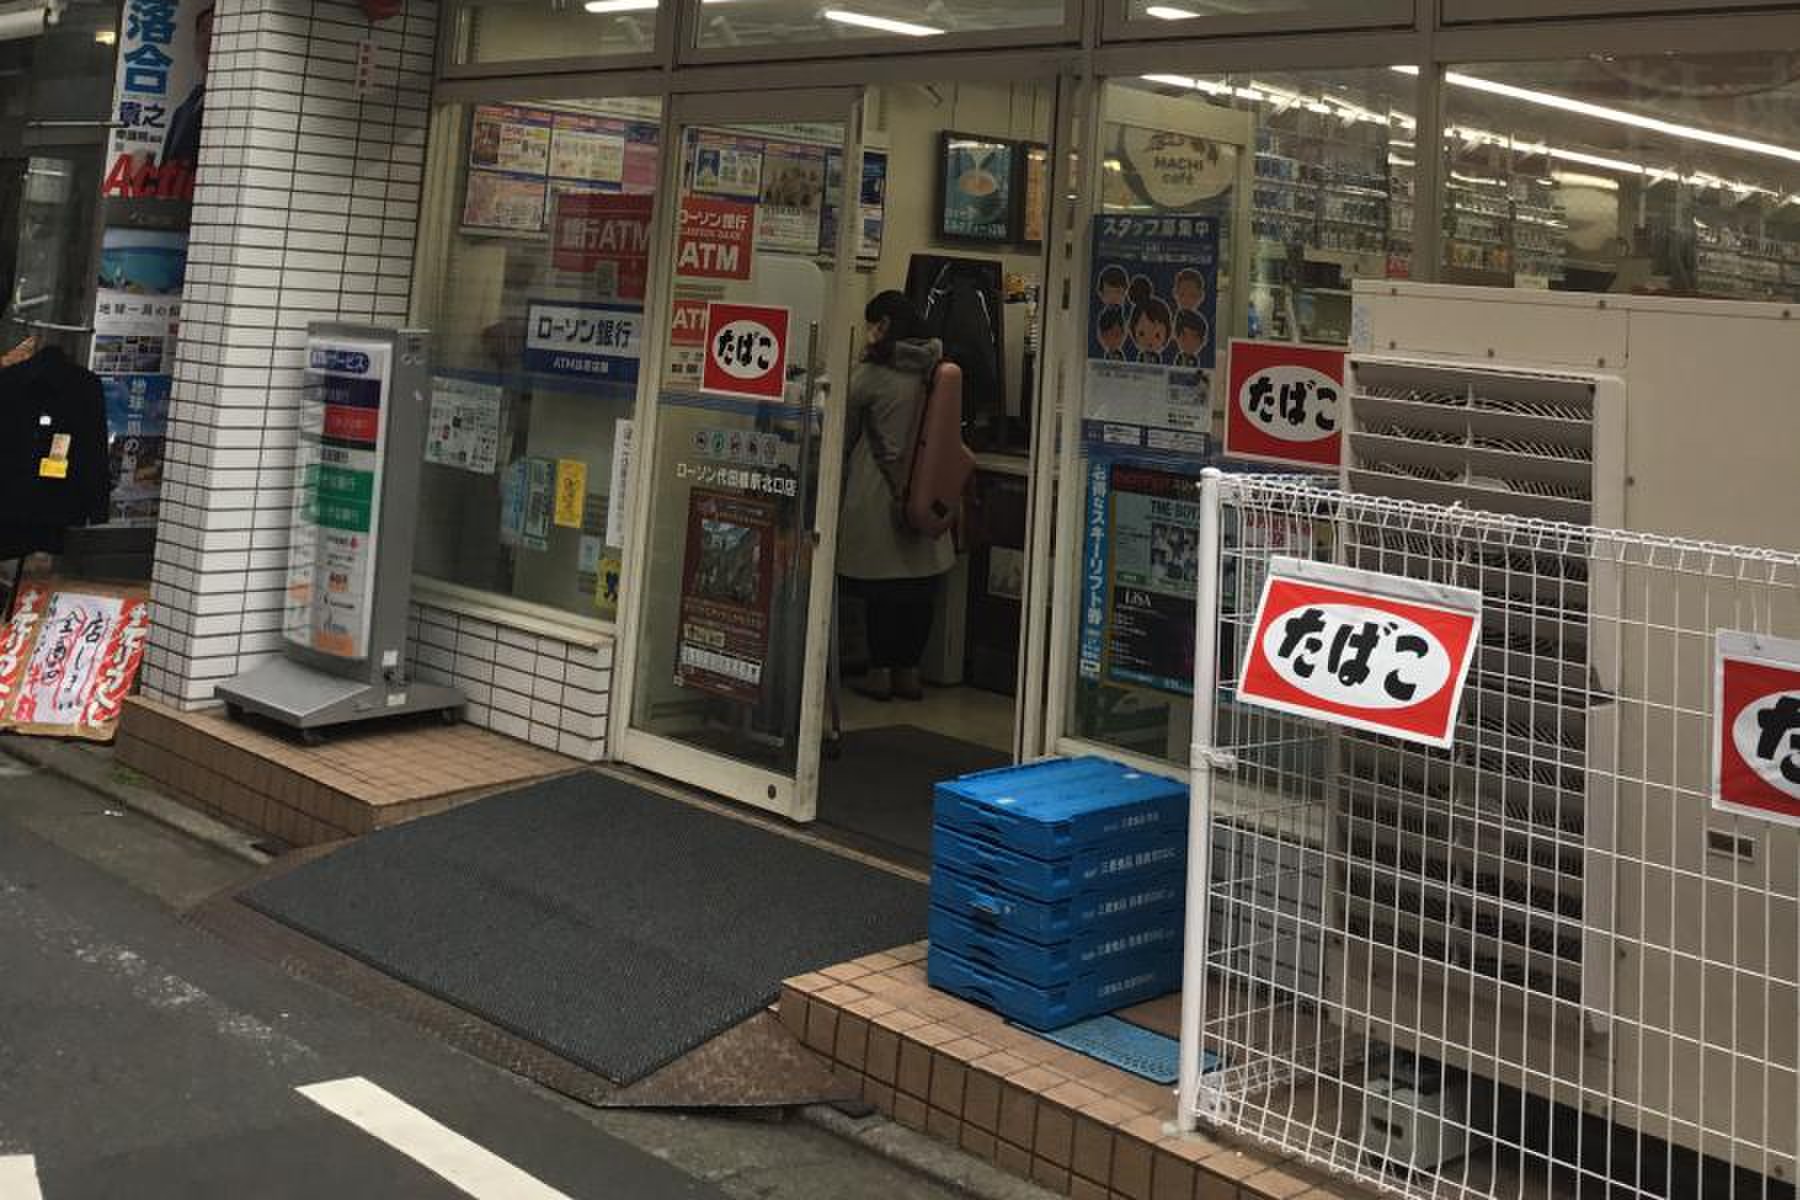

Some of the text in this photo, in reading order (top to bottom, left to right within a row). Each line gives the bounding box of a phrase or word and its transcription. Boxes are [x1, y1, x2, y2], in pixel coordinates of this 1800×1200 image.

[679, 243, 740, 272] ATM
[537, 314, 634, 348] ローソン銀行
[717, 328, 772, 370] たばこ
[1248, 376, 1338, 431] たばこ
[1276, 607, 1430, 702] たばこ
